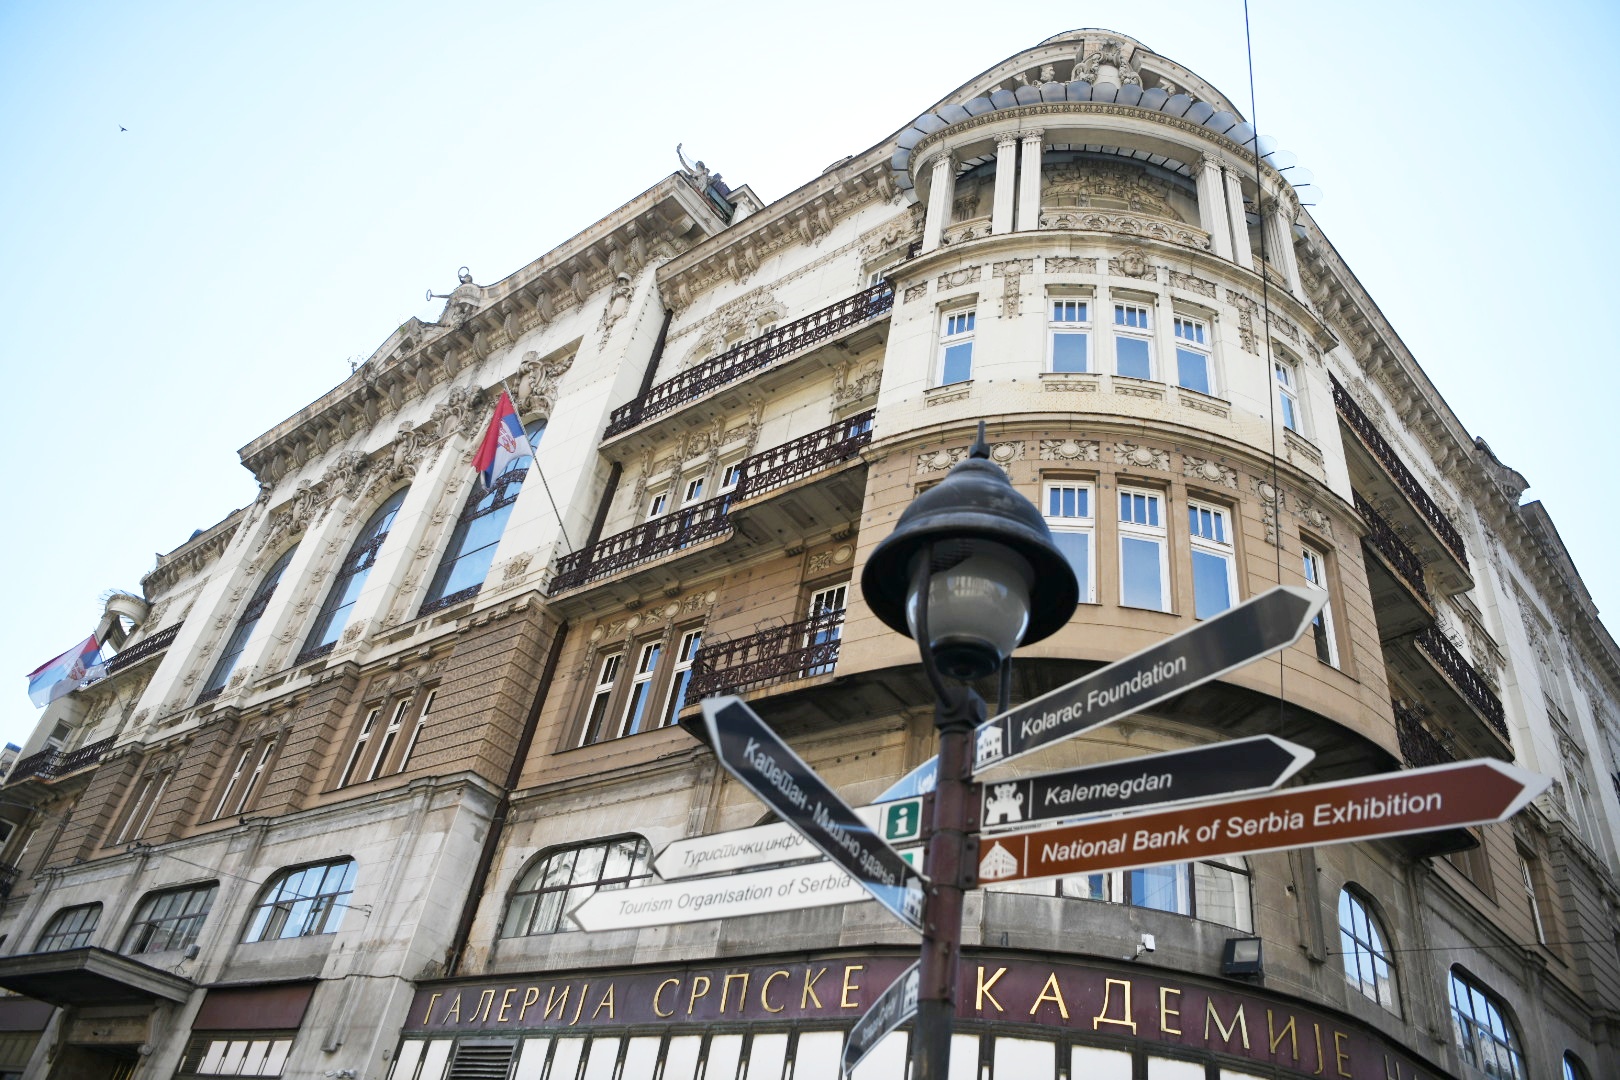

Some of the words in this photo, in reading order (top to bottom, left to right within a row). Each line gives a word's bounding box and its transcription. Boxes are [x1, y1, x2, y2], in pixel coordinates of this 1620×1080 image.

[1020, 701, 1083, 739] Kolarac
[1087, 655, 1187, 713] Foundation
[743, 737, 808, 811] Капетан
[1044, 773, 1172, 806] Kalemegdan
[683, 839, 764, 867] Туристички
[1041, 832, 1127, 864] National
[1132, 825, 1190, 851] Bank
[1196, 819, 1221, 842] of
[1225, 809, 1304, 838] Serbia
[1313, 791, 1442, 826] Exhibition
[618, 897, 673, 916] Tourism
[677, 884, 773, 910] Organisation
[778, 878, 796, 897] of
[799, 874, 851, 894] Serbia
[423, 983, 616, 1026] ГАЛЕРИЈА
[653, 965, 864, 1018] СРПСКЕ
[975, 966, 1352, 1077] КАДЕМИЈЕ
